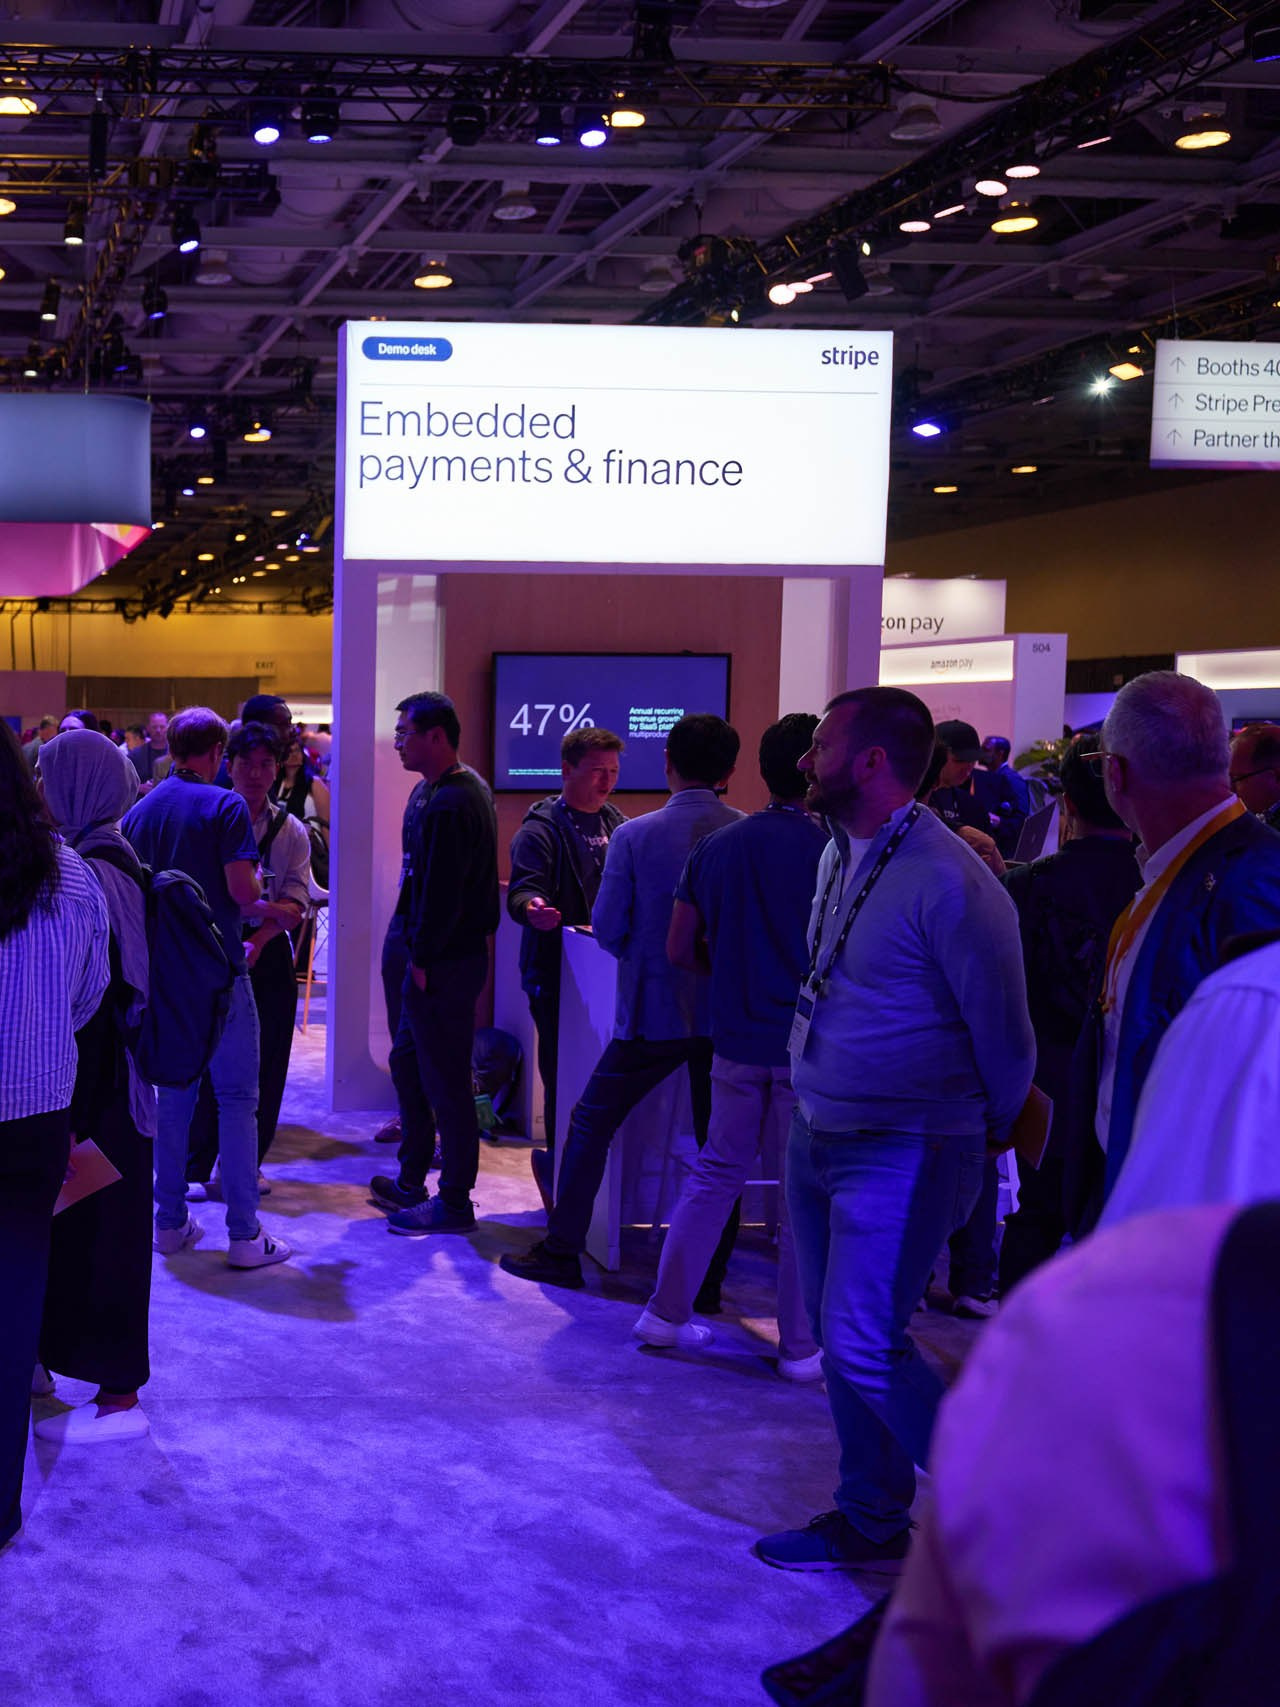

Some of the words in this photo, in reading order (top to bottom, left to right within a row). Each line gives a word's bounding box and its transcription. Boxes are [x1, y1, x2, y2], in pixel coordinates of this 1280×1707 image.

[378, 343, 410, 355] Demo
[411, 344, 437, 356] desk
[821, 346, 880, 370] stripe
[1197, 357, 1260, 377] Booths
[1195, 393, 1249, 415] Stripe
[360, 401, 576, 439] Embedded
[1193, 429, 1259, 448] Partner
[359, 450, 553, 489] payments
[564, 448, 592, 484] &
[603, 449, 743, 486] finance
[910, 616, 944, 635] pay
